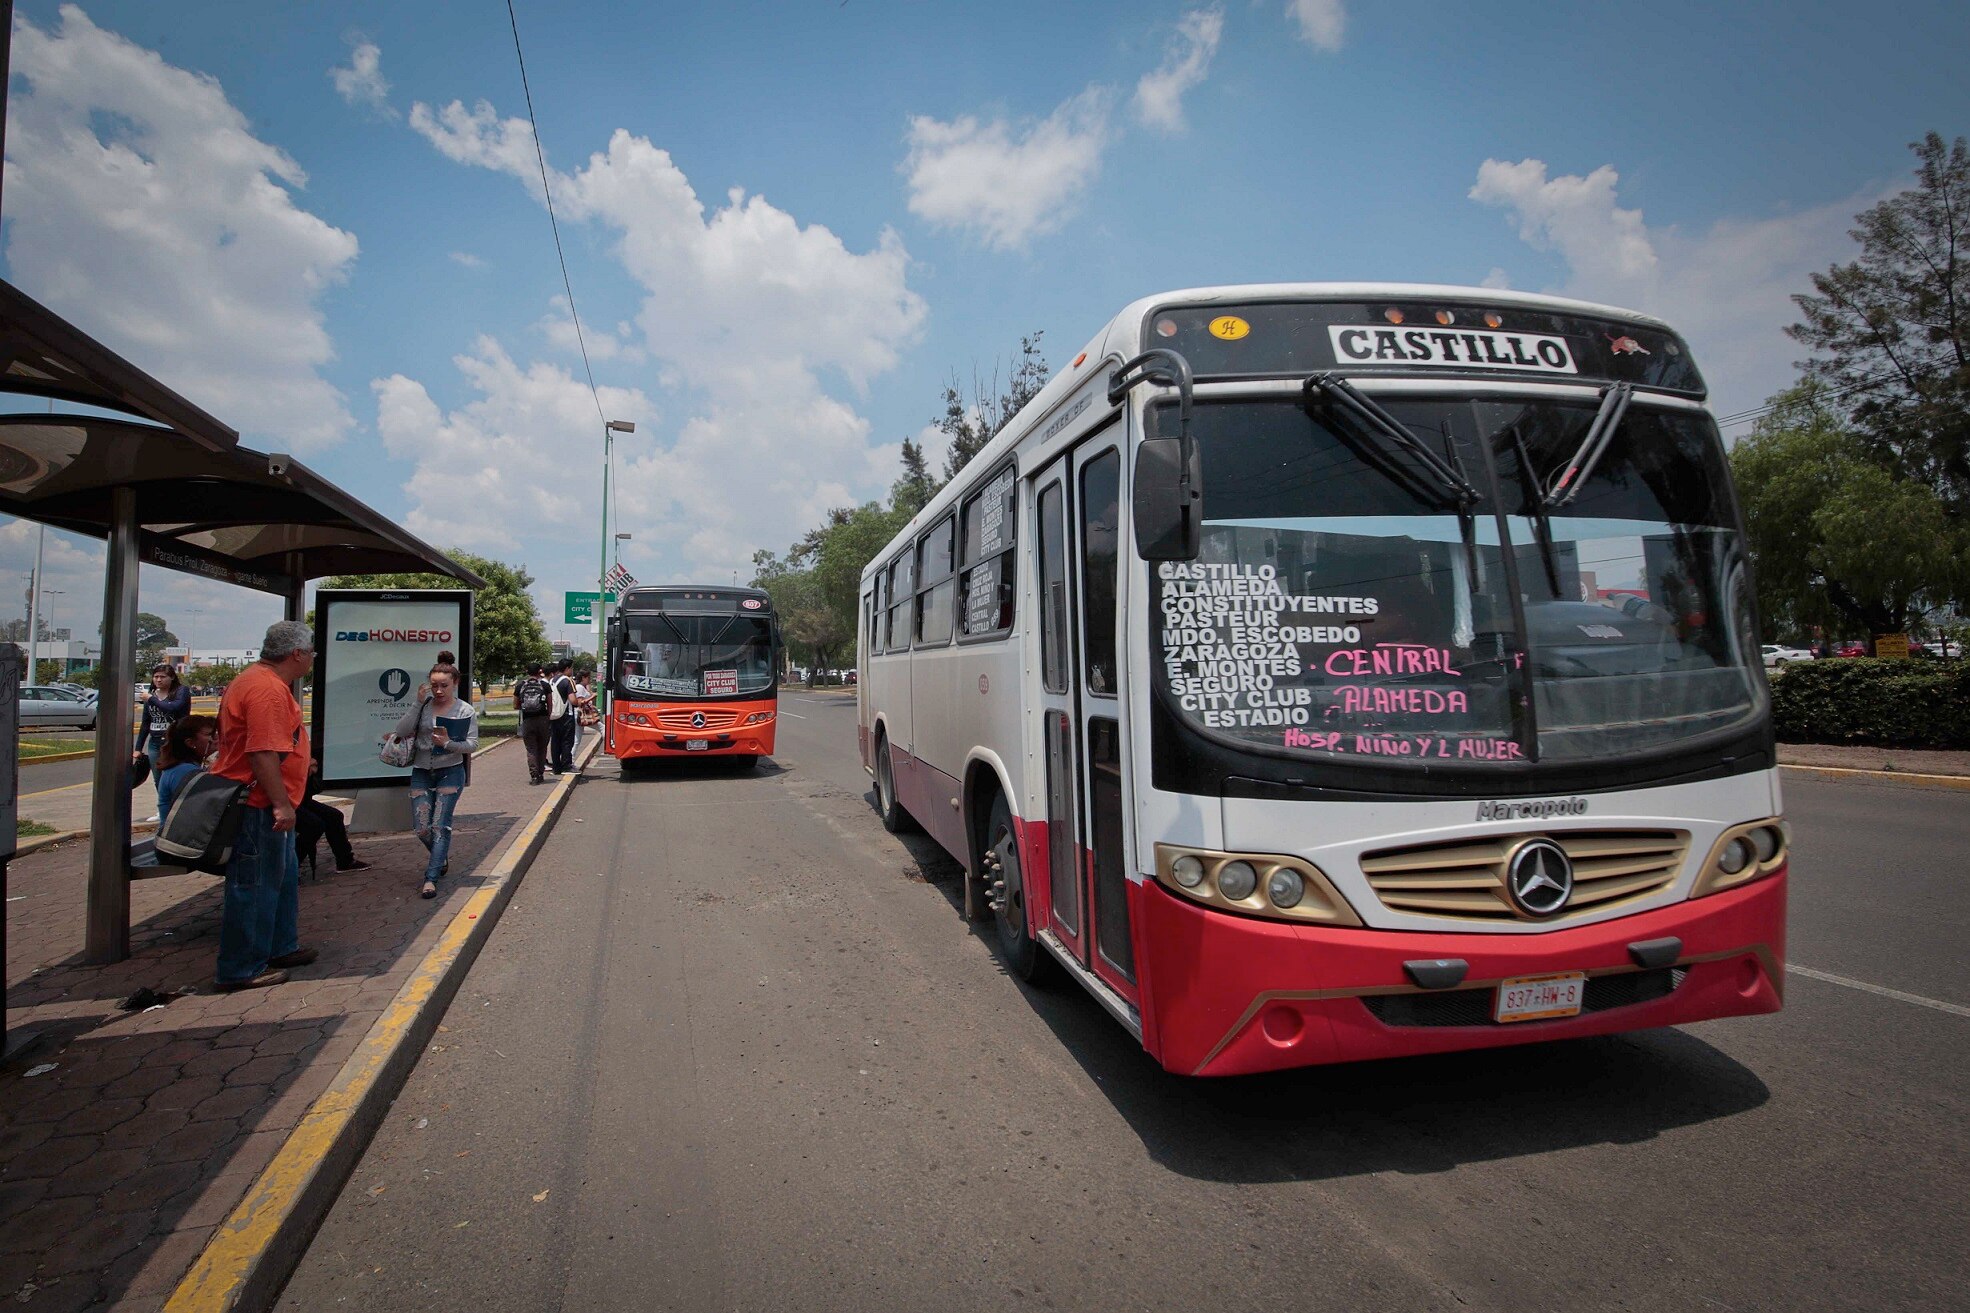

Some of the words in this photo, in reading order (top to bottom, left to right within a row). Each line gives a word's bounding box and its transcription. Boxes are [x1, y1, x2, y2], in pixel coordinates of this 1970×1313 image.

[1338, 328, 1569, 369] CASTILLO
[983, 495, 1002, 517] PASTEUR
[981, 528, 998, 546] SEGURO
[981, 542, 990, 556] CITY
[990, 537, 1002, 551] CLUB
[1157, 563, 1276, 581] CASTILLO
[1161, 579, 1283, 598] ALAMEDA
[972, 600, 977, 610] LA
[977, 593, 990, 608] MUJER
[1161, 595, 1379, 615] CONSTITUYENTES
[972, 608, 988, 622] CENTRAL
[1165, 611, 1280, 629] PASTEUR
[335, 629, 453, 643] DESHONESTO
[972, 621, 990, 634] CASTILLO
[1162, 627, 1224, 646] MDO.
[1231, 626, 1361, 644] ESCOBEDO
[1164, 642, 1300, 663] ZARAGOZA
[1324, 642, 1462, 676] CENTRAL
[1167, 661, 1191, 679] E.
[1197, 658, 1302, 678] MONTES
[629, 677, 651, 689] 94
[1170, 674, 1274, 696] SEGURO
[1180, 691, 1240, 711] CITY
[1246, 688, 1312, 708] CLUB
[1333, 685, 1468, 714] ALAMEDA
[1203, 707, 1310, 727] ESTADIO
[1416, 738, 1431, 757] Y
[1457, 738, 1525, 760] MUJER
[1476, 797, 1588, 822] Marcopolo
